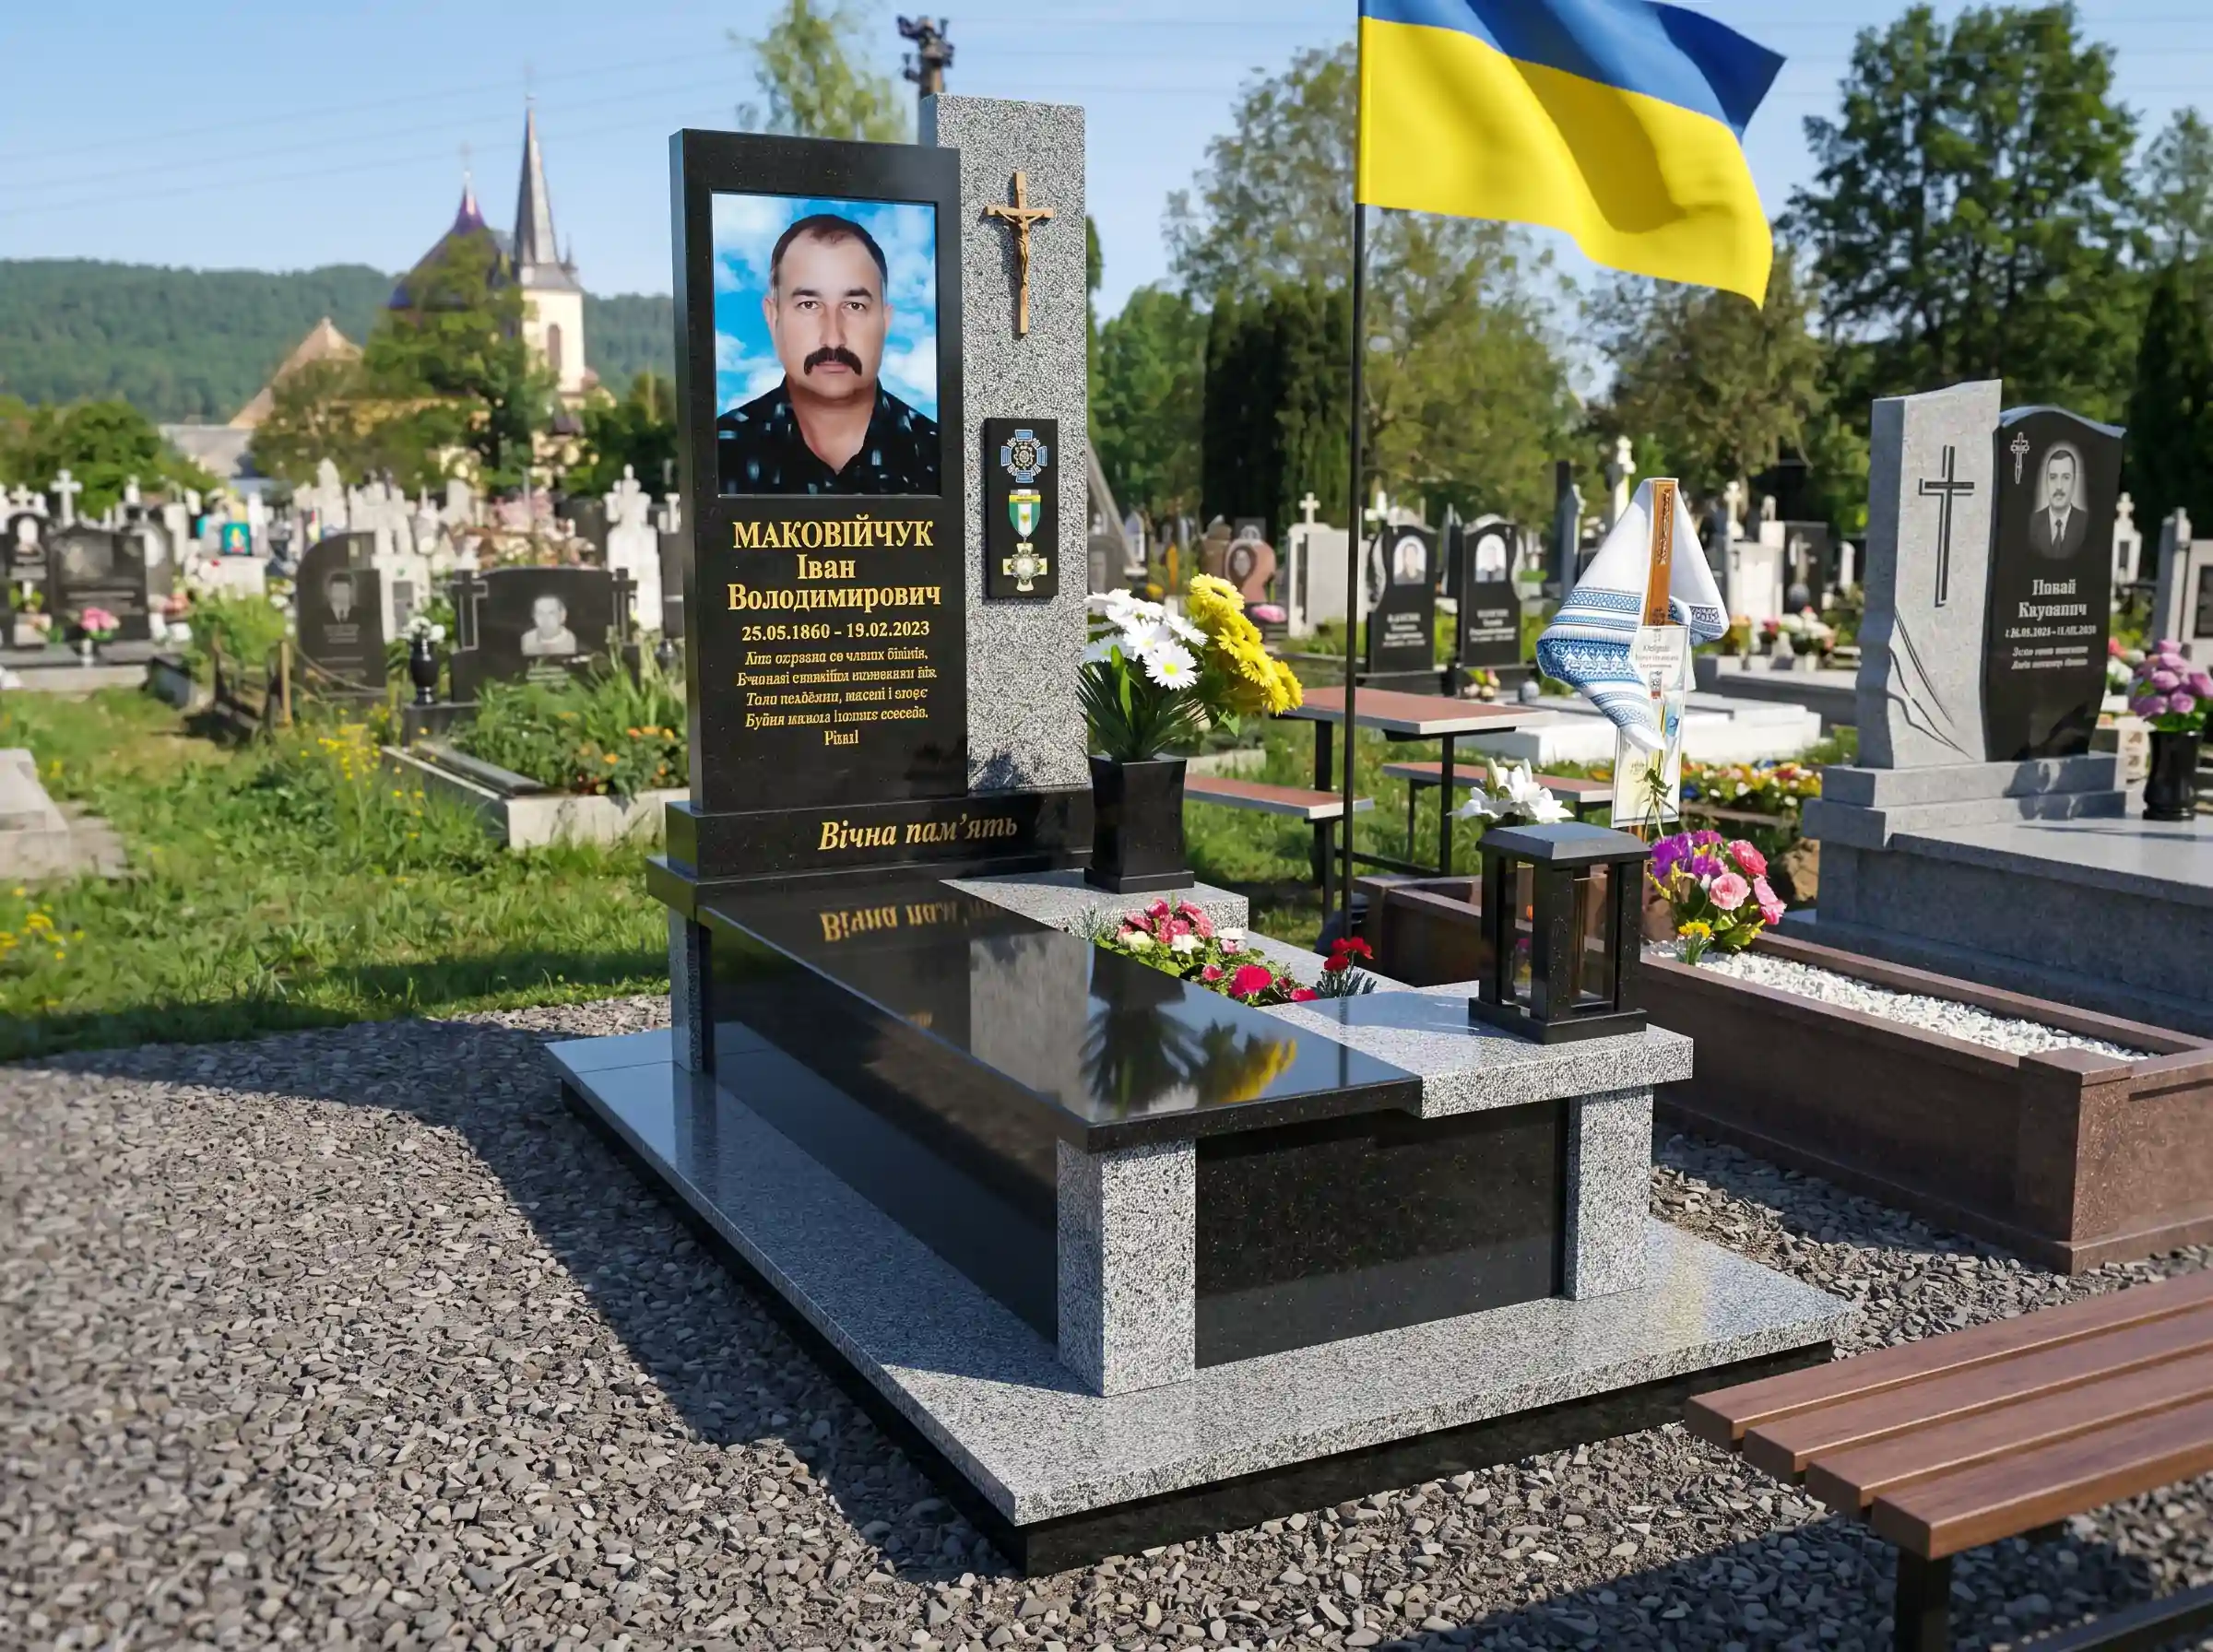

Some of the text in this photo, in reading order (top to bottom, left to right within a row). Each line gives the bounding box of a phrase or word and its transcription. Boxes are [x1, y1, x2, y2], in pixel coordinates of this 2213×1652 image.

[733, 513, 933, 549] МАКОВІЙЧУК
[797, 553, 856, 579] Іван
[728, 583, 941, 614] Володимирович
[741, 623, 830, 642] 25.05.1860
[846, 620, 930, 638] 19.02.2023
[818, 820, 897, 851] Вічна
